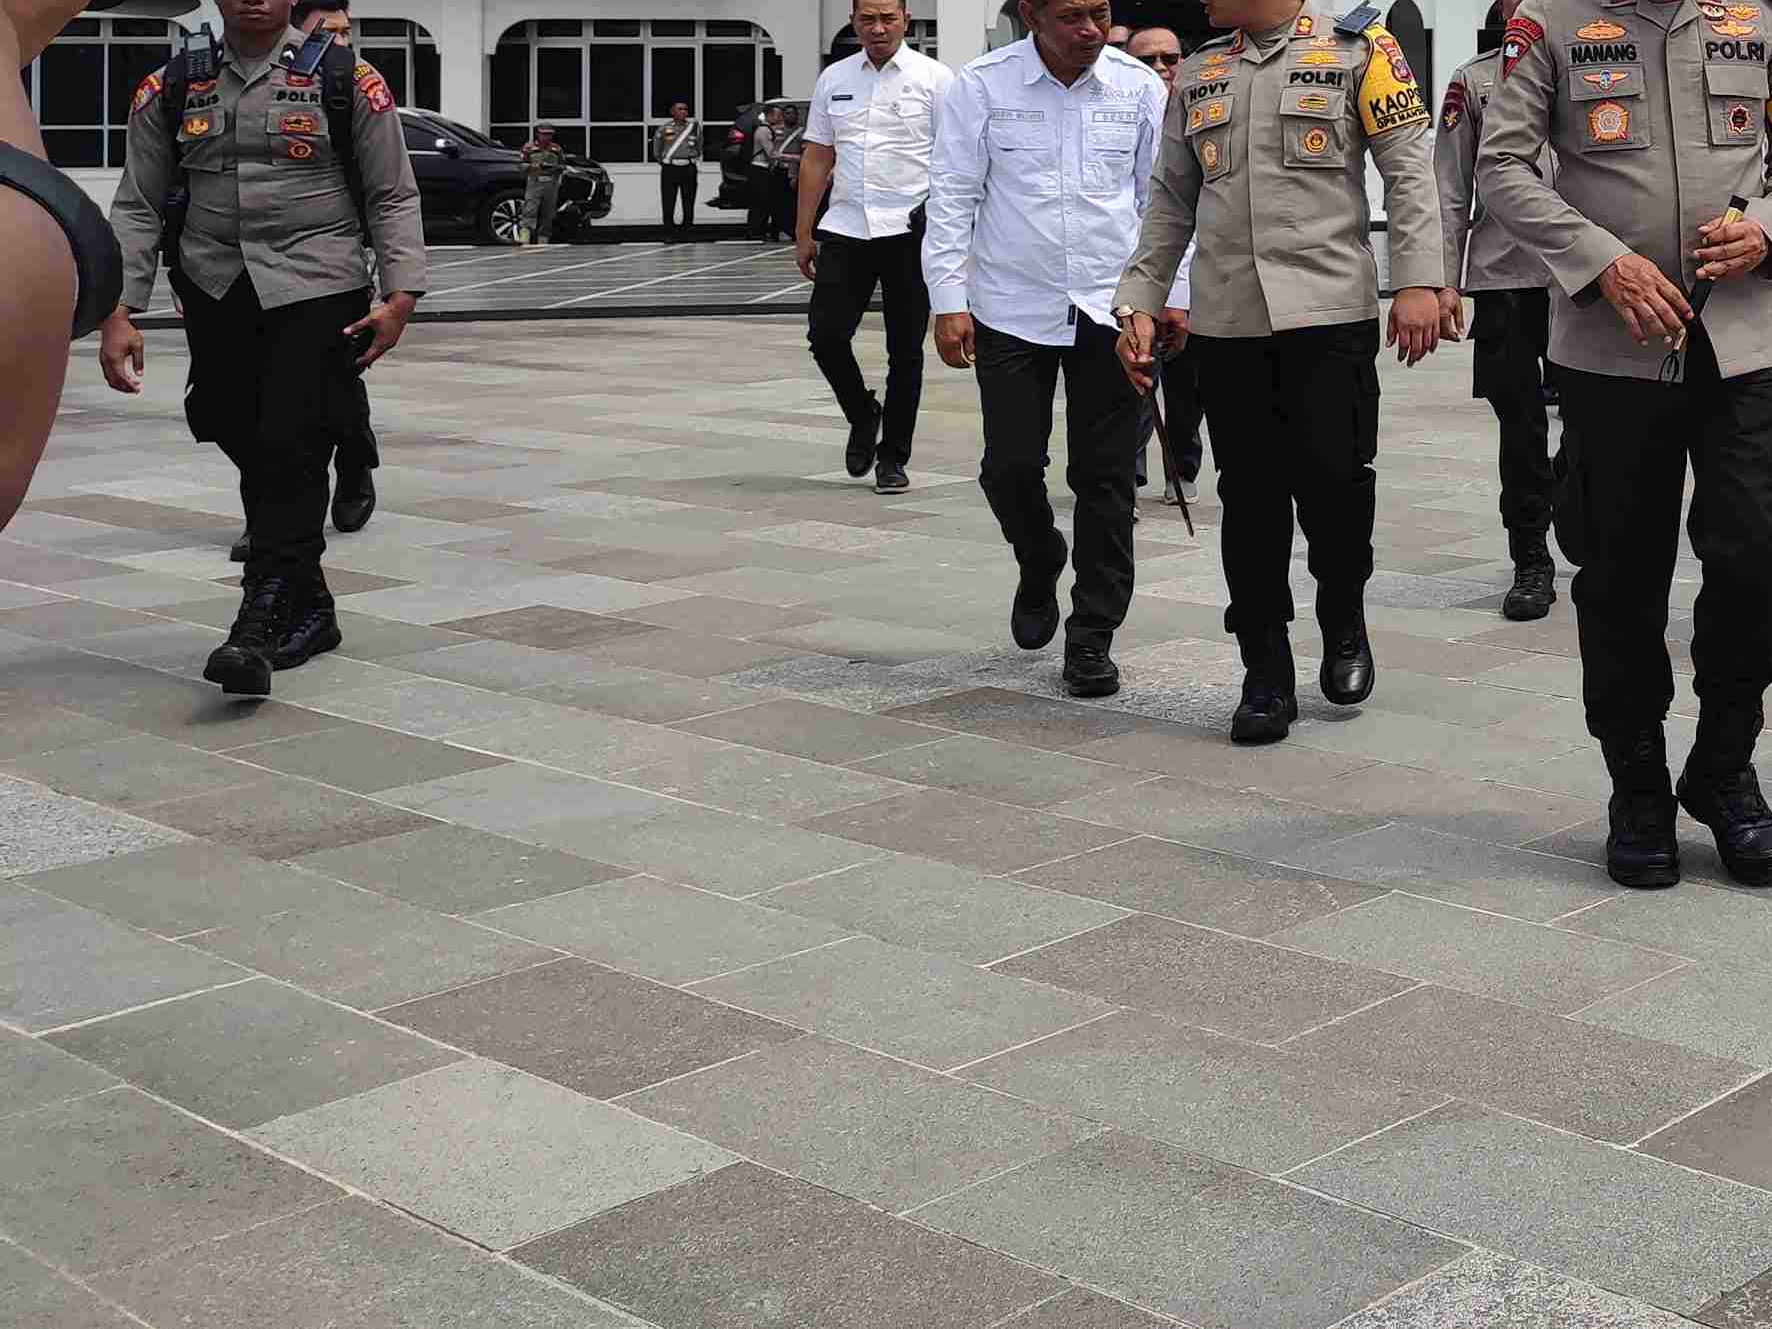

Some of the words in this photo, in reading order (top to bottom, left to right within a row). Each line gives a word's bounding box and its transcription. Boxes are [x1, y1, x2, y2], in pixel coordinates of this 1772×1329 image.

[1571, 44, 1637, 64] NANANG
[1705, 41, 1765, 62] POLRI
[1289, 71, 1343, 87] POLRI
